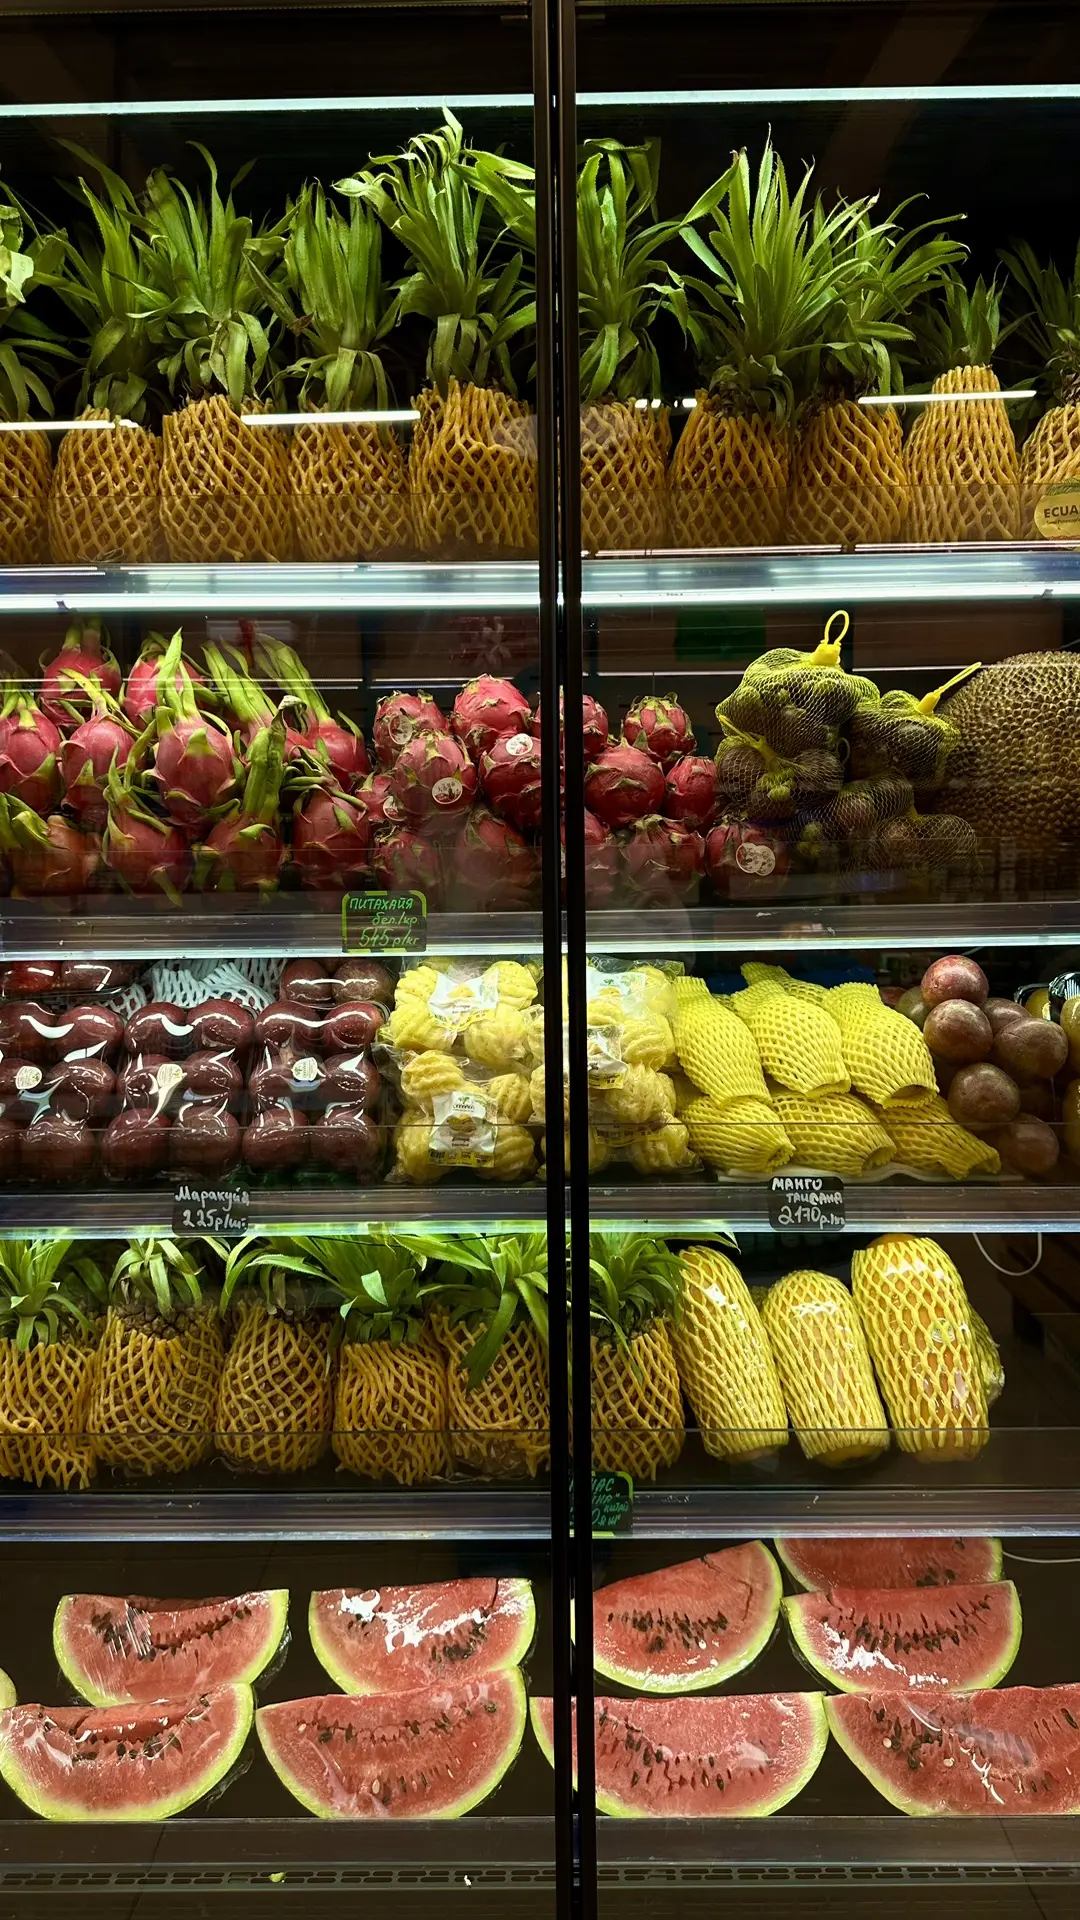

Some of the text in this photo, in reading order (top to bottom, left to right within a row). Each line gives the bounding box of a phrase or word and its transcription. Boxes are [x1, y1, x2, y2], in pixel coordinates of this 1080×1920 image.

[1043, 504, 1080, 518] ECUA
[350, 897, 414, 910] ПИТАХАЙЯ
[771, 1177, 823, 1191] МАНГО
[174, 1185, 250, 1211] Маракуйя
